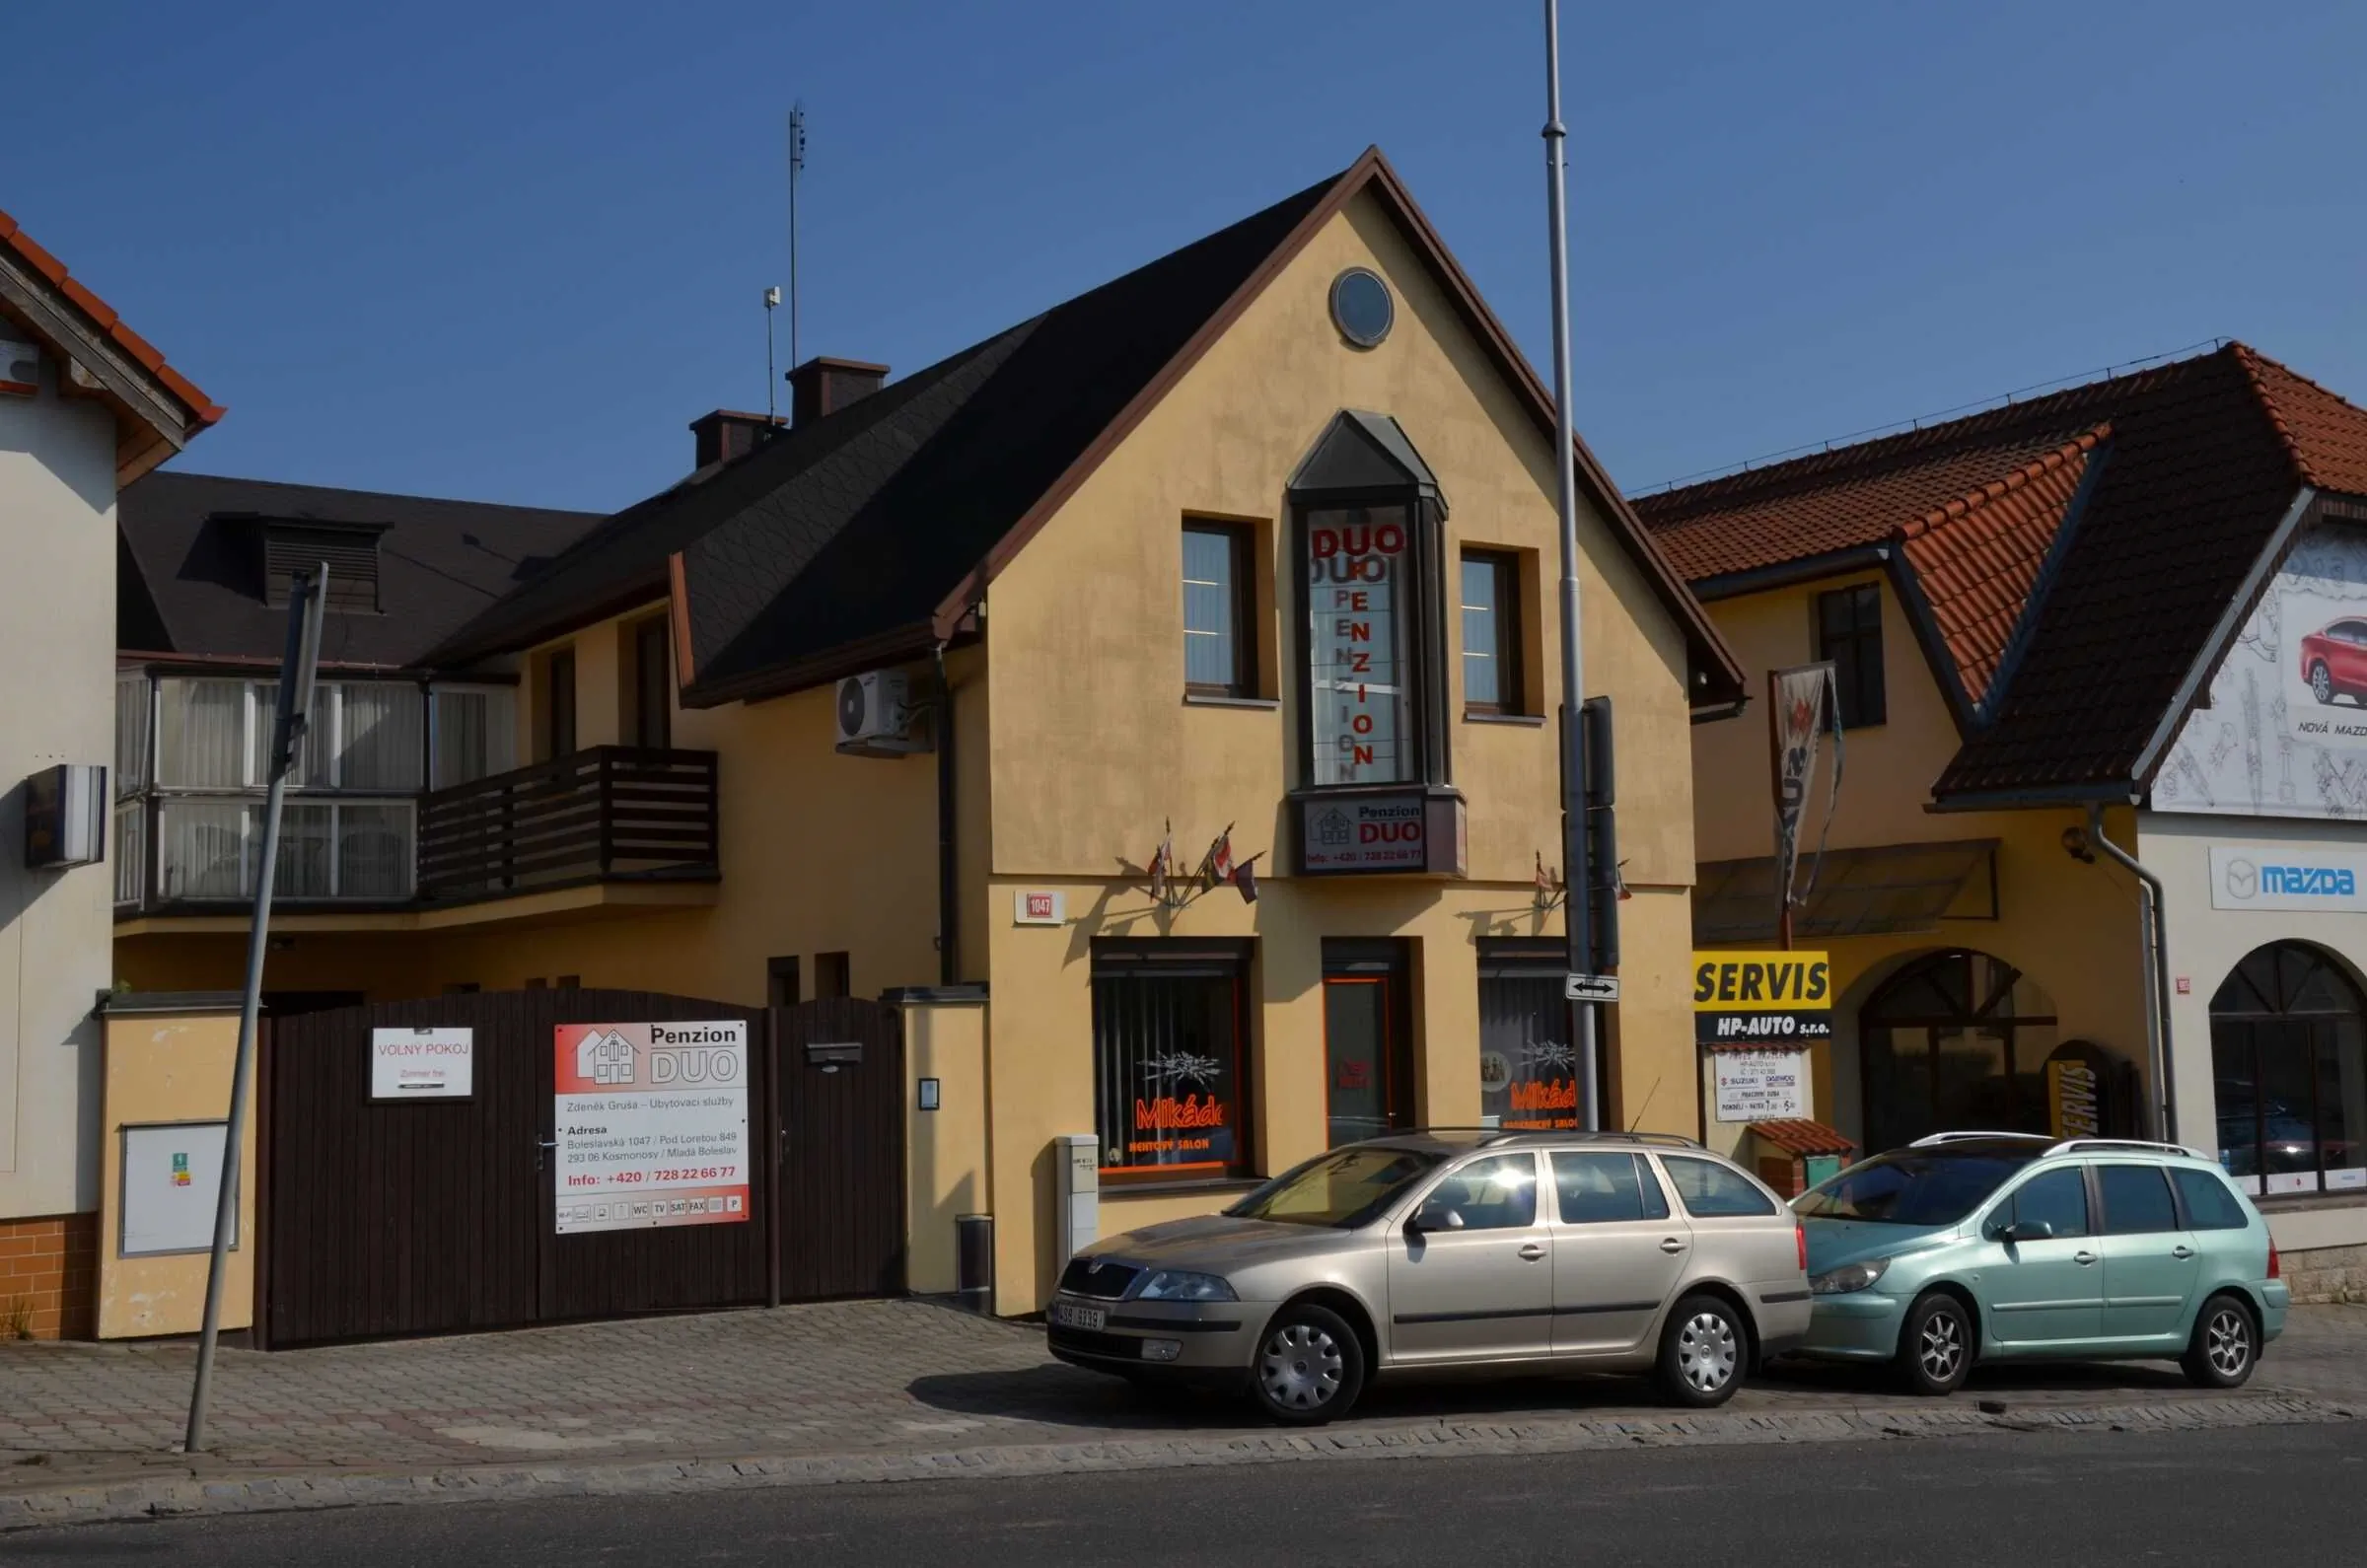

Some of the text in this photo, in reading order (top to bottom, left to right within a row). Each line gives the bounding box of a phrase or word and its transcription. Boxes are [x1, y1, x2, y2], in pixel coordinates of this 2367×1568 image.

[1312, 524, 1406, 558] DUO
[1350, 562, 1374, 765] PENZION
[2298, 720, 2329, 734] NOVÁ
[1359, 806, 1420, 818] Penzion
[1359, 821, 1420, 844] DUO
[1031, 898, 1050, 913] 1047
[1694, 962, 1828, 1003] SERVIS
[1717, 1016, 1830, 1035] HP-AUTO s.r.o.
[651, 1026, 737, 1044] Penzion
[426, 1042, 468, 1055] POKOJ
[650, 1049, 739, 1084] DUO
[1511, 1078, 1576, 1110] Mikád
[567, 1125, 608, 1135] Adresa
[628, 1136, 651, 1146] 1047
[659, 1135, 678, 1144] Pod
[719, 1132, 737, 1142] 849
[1177, 1138, 1209, 1152] SALON
[567, 1153, 585, 1164] 293
[588, 1152, 600, 1162] 06
[568, 1175, 601, 1186] Info:
[607, 1172, 642, 1183] +420
[654, 1170, 679, 1181] 728
[681, 1168, 698, 1179] 22
[701, 1168, 717, 1178] 66
[720, 1167, 736, 1177] 77
[632, 1205, 647, 1215] WC
[655, 1204, 665, 1213] TV
[671, 1202, 686, 1212] SAT
[689, 1201, 704, 1211] FAX
[732, 1199, 738, 1208] P
